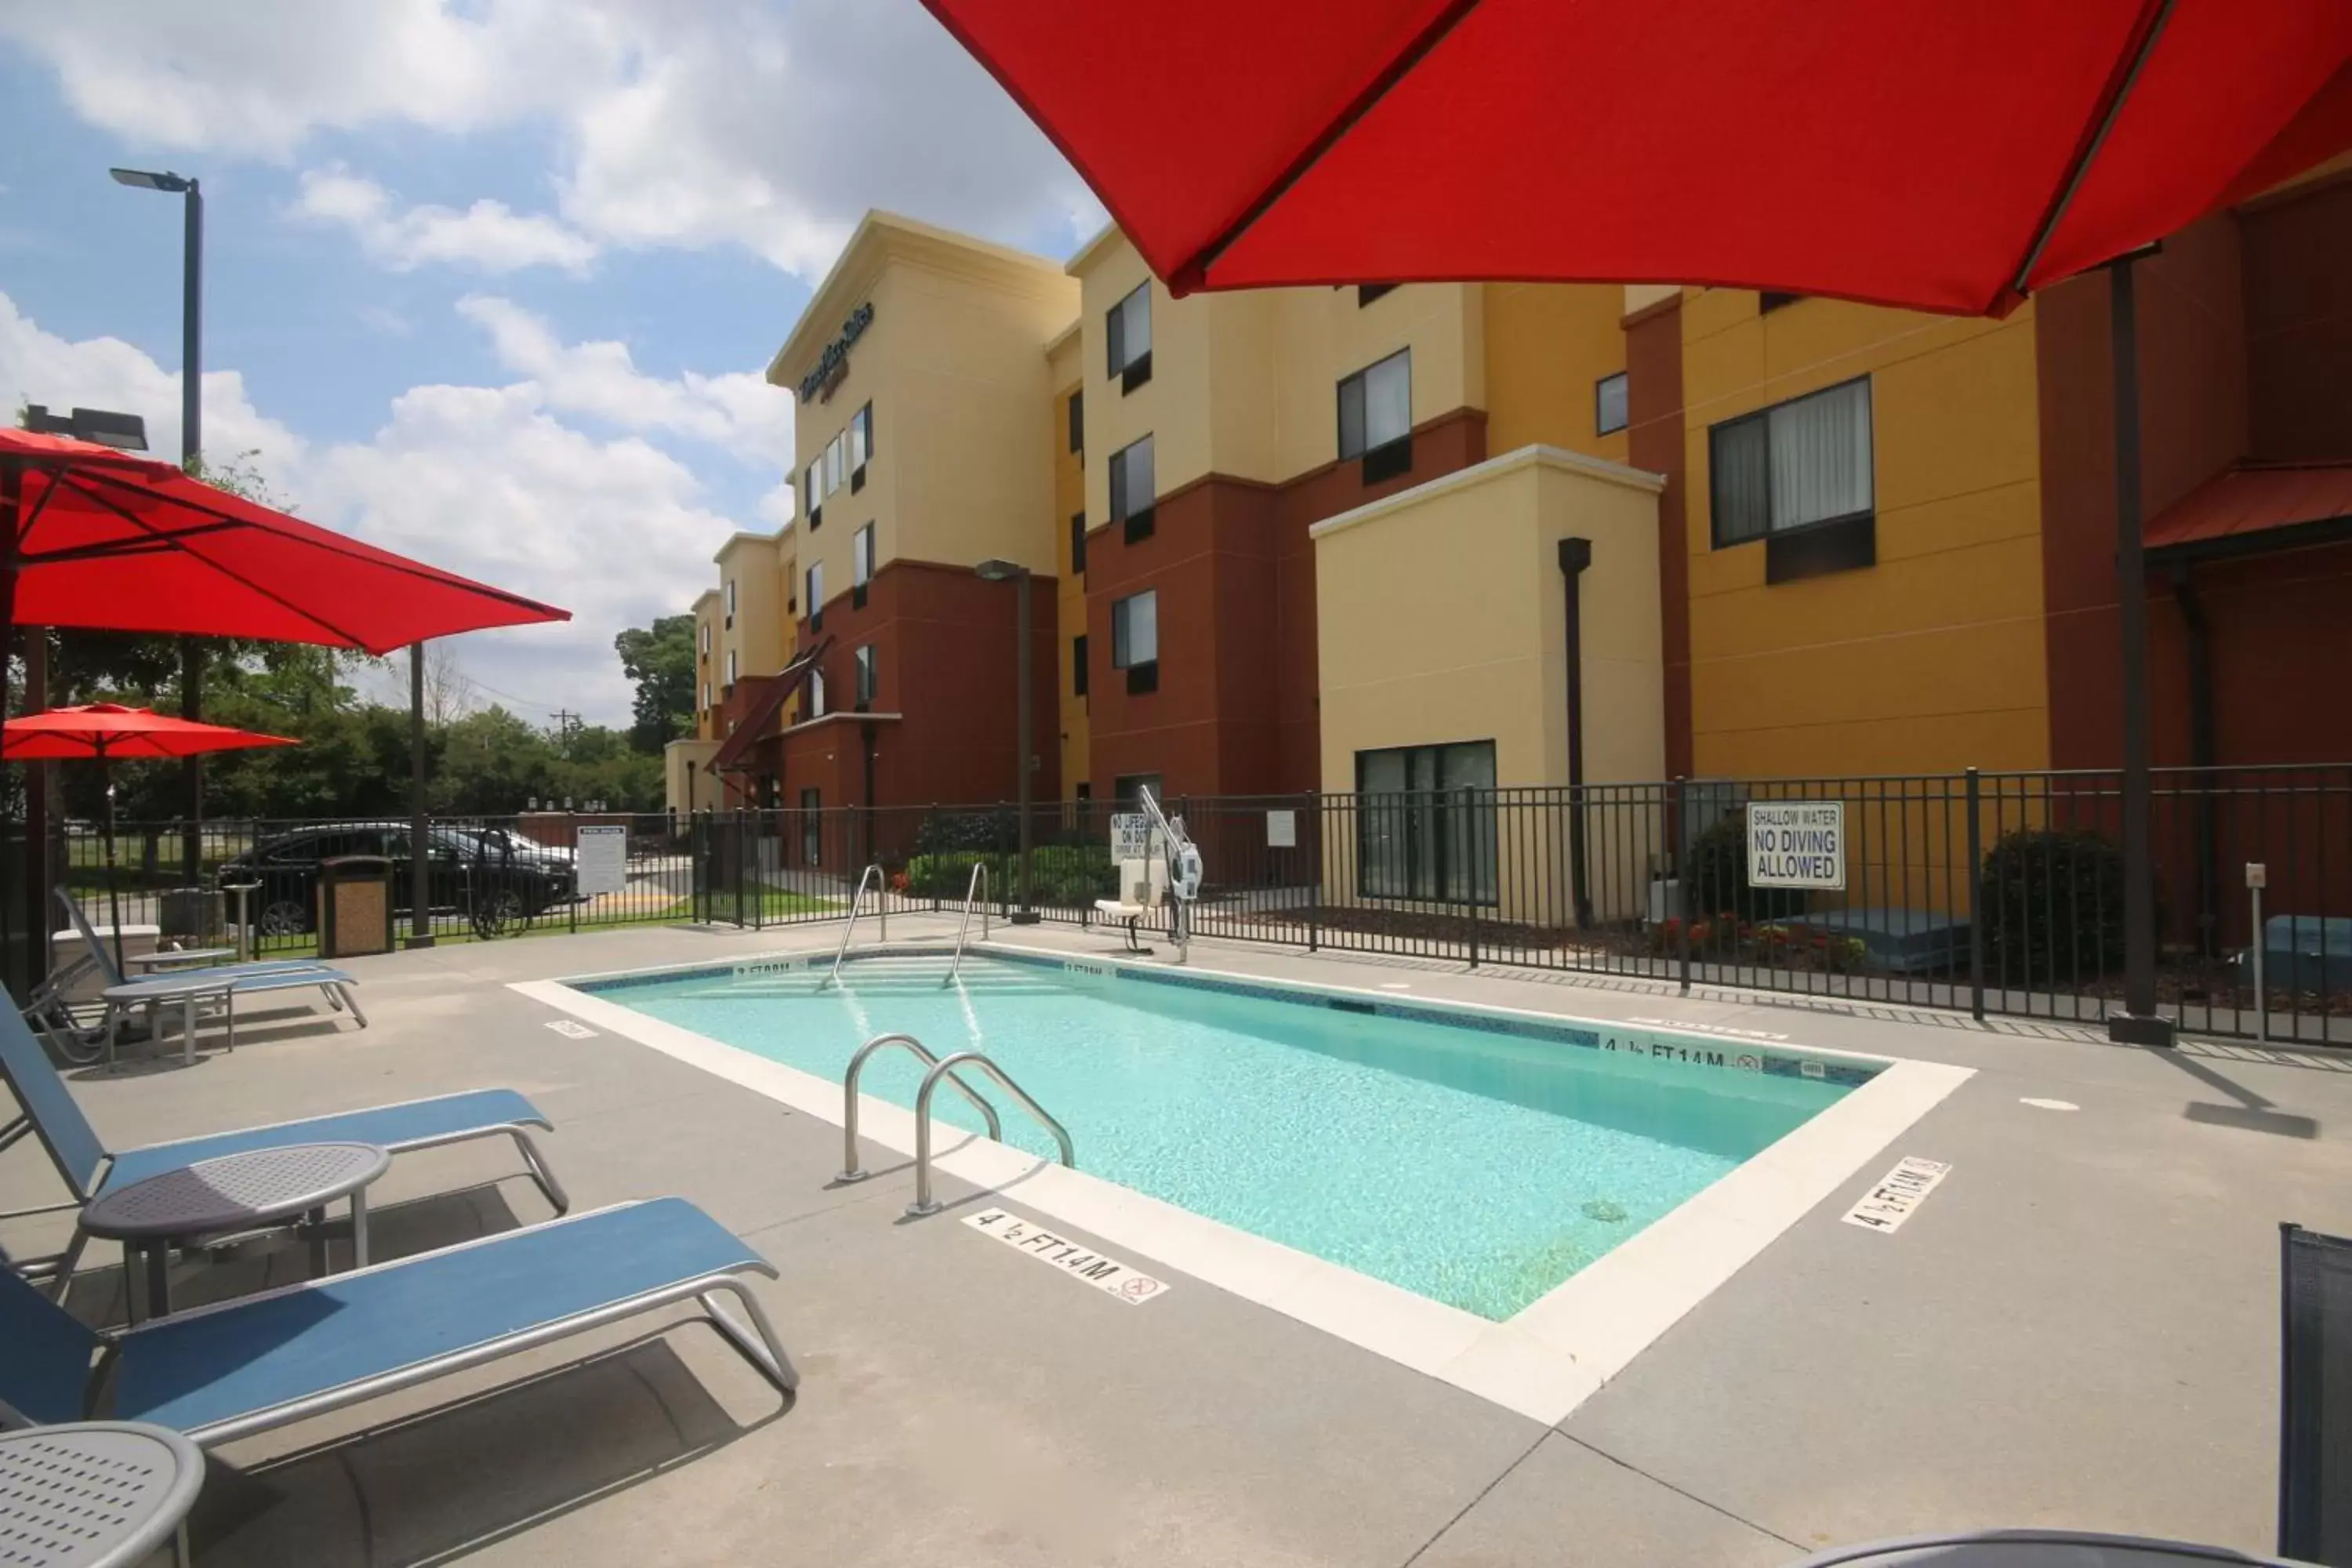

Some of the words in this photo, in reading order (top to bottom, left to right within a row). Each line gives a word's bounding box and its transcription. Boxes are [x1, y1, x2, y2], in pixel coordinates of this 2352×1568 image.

[1754, 810, 1799, 826] SHALLOW
[1803, 810, 1836, 825] WATER
[1754, 829, 1777, 852] NO
[1781, 829, 1836, 854] DIVING
[1757, 855, 1835, 879] ALLOWED
[978, 1214, 1006, 1225] 4
